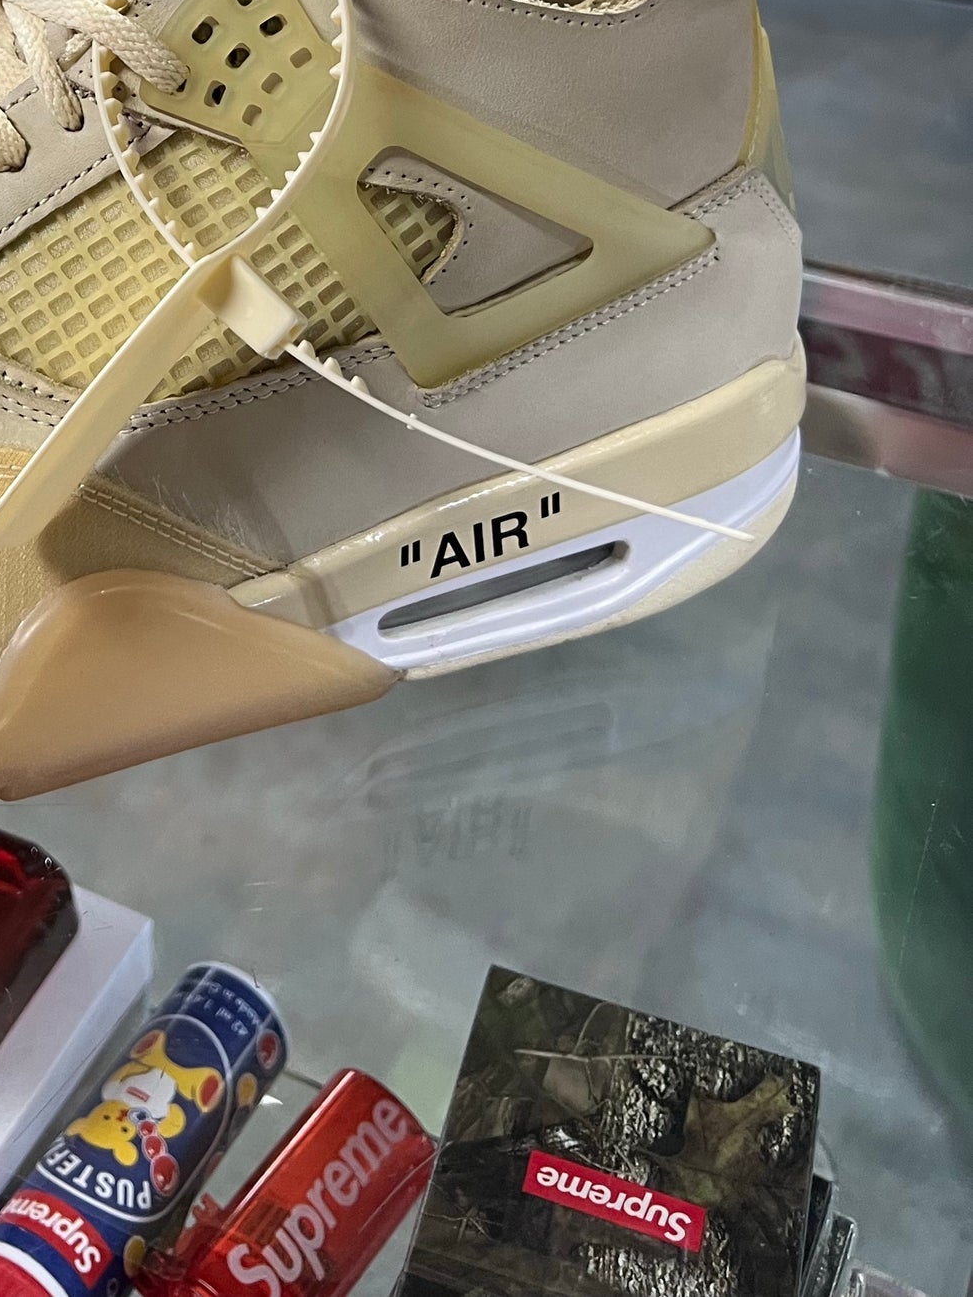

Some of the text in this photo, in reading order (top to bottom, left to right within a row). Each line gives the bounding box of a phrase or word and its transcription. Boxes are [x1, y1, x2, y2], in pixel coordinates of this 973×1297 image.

[400, 492, 561, 579] "AIR"
[1, 1196, 101, 1273] Suprem
[227, 1099, 408, 1297] Supreme
[536, 1166, 692, 1242] Supreme
